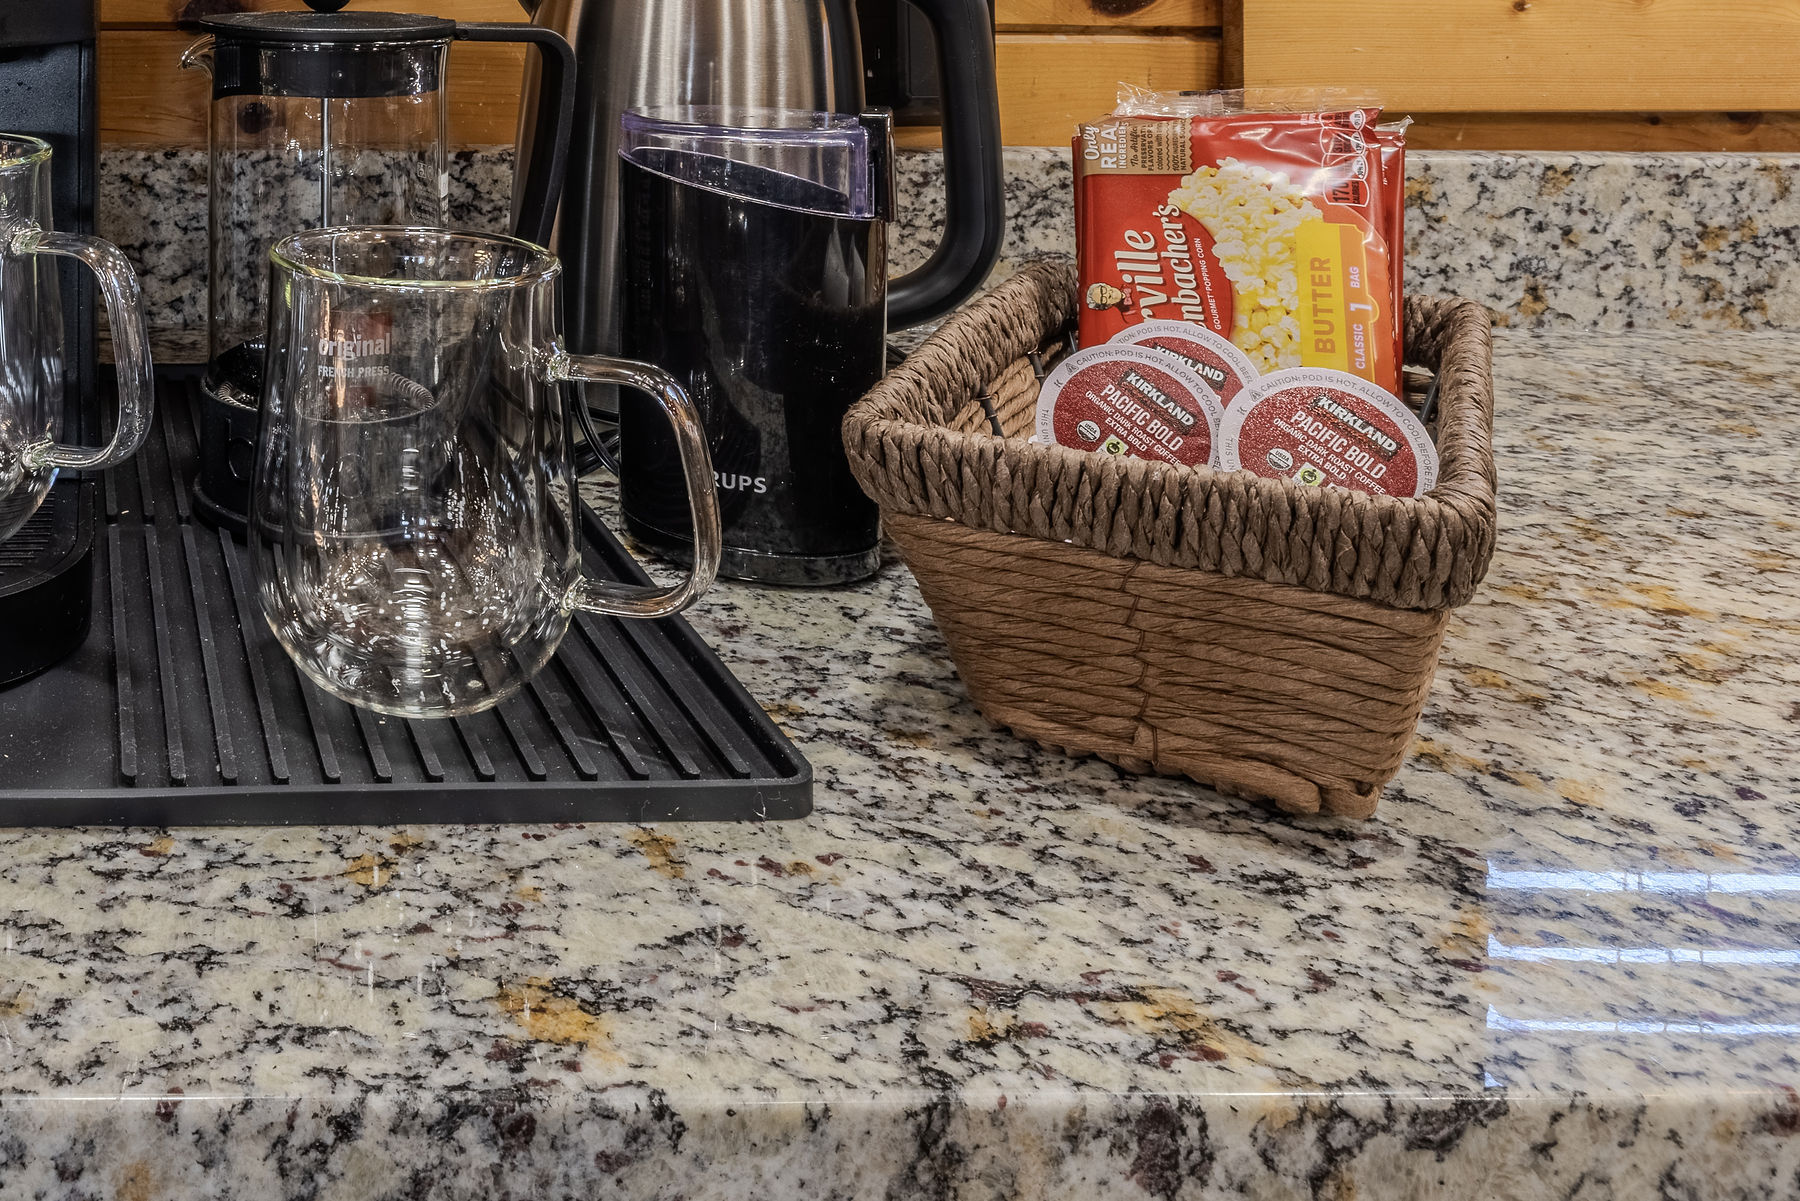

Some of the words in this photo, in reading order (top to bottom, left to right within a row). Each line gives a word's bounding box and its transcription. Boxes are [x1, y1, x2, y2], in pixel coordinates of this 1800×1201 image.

[1084, 124, 1100, 160] Only
[1101, 121, 1120, 169] REAL
[1152, 204, 1207, 329] nbacher's
[1194, 237, 1205, 259] CORN
[1114, 229, 1168, 323] rville
[1199, 259, 1212, 292] POPPING
[1349, 266, 1361, 289] BAG
[1207, 294, 1222, 330] GOURMET
[1310, 257, 1336, 354] BUTTER
[1349, 302, 1373, 312] 1
[318, 332, 391, 361] original
[1136, 326, 1153, 335] POD
[1182, 328, 1212, 342] ALLOW
[1212, 339, 1223, 349] TO
[1222, 347, 1241, 368] COOL
[1353, 323, 1366, 370] CLASSIC
[357, 365, 390, 378] PRESS
[1076, 350, 1114, 366] CAUTION:
[1115, 349, 1134, 357] POD
[1135, 351, 1144, 359] IS
[1165, 362, 1193, 384] ALLOW
[1193, 382, 1204, 394] TO
[1201, 394, 1218, 417] COOL
[1041, 409, 1050, 426] THIS
[1085, 390, 1115, 415] ORGANIC
[1112, 411, 1132, 430] DARK
[1131, 426, 1156, 447] ROAST
[1101, 384, 1151, 426] PACIFIC
[1146, 419, 1184, 451] BOLD
[1126, 372, 1195, 426] KIRKLAND
[1041, 429, 1050, 443] UNI
[1104, 417, 1128, 438] EXTRA
[1127, 434, 1148, 452] BOLD
[1260, 375, 1301, 392] CAUTION:
[1325, 375, 1334, 383] IS
[1359, 386, 1393, 408] ALLOW
[1393, 407, 1404, 418] TO
[1403, 418, 1421, 442] COOL
[1417, 443, 1433, 477] BEFORE
[1318, 396, 1397, 451] KIRKLAND
[1273, 418, 1307, 442] ORGANIC
[1305, 439, 1329, 457] DARK
[1328, 453, 1356, 474] ROAST
[1354, 471, 1386, 495] COFFEE
[1275, 450, 1290, 462] USDA
[1290, 410, 1348, 453] PACIFIC
[1343, 445, 1387, 479] BOLD
[1298, 444, 1324, 466] EXTRA
[1323, 462, 1347, 480] BOLD
[713, 471, 768, 494] RUPS
